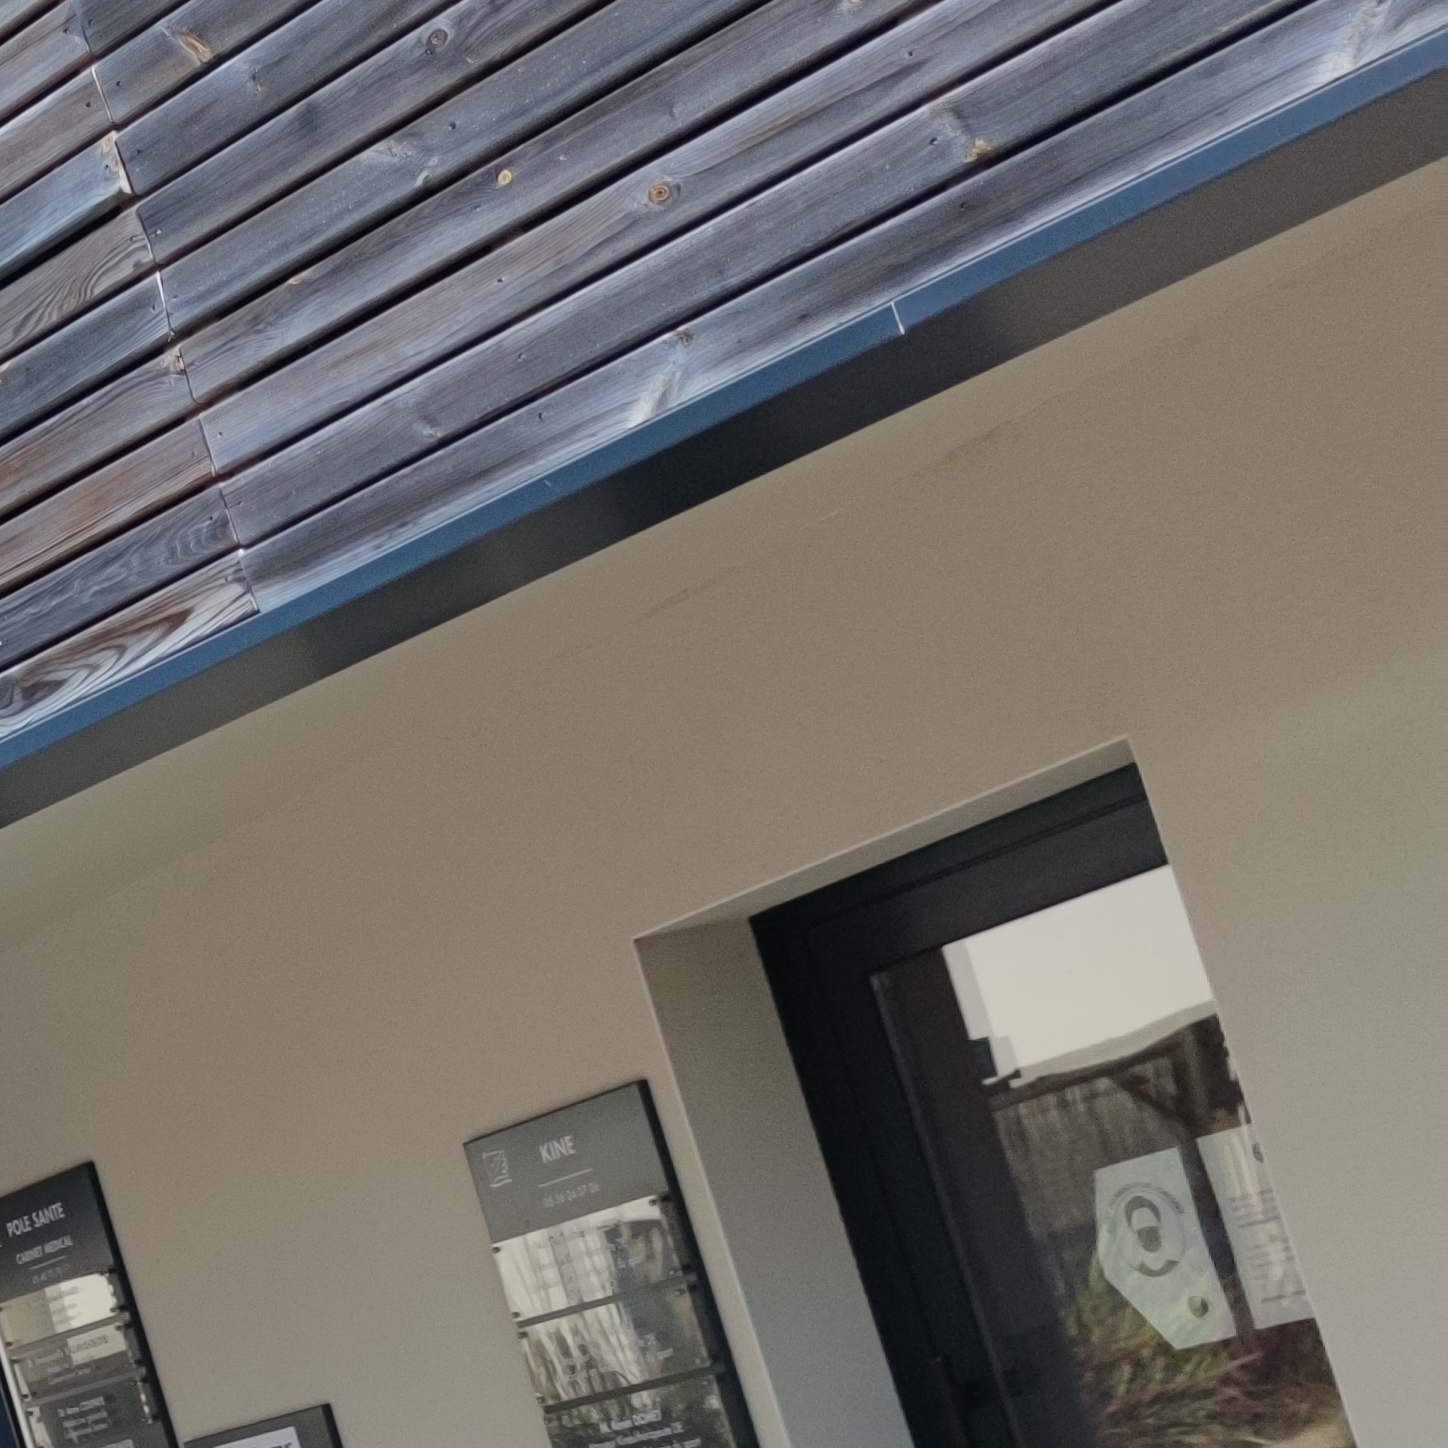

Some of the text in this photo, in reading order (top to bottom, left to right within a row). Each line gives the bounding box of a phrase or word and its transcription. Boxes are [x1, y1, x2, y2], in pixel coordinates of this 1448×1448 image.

[539, 1135, 577, 1164] KINE
[6, 1202, 65, 1238] POLE SANTE
